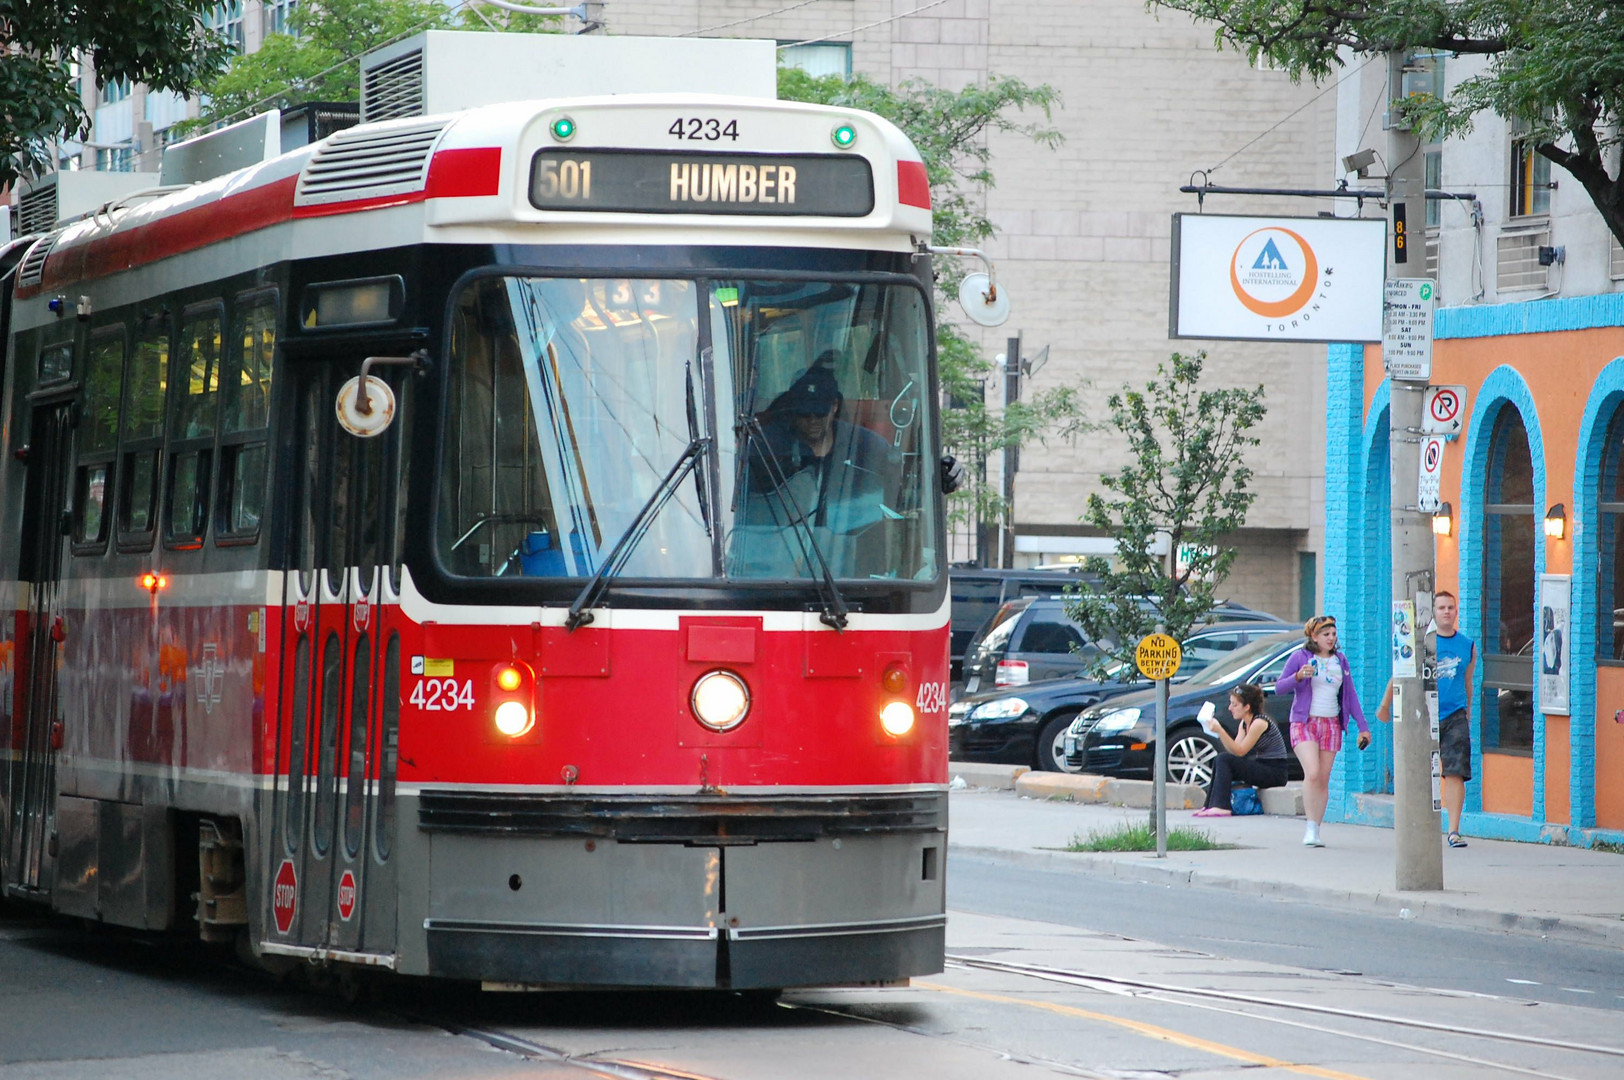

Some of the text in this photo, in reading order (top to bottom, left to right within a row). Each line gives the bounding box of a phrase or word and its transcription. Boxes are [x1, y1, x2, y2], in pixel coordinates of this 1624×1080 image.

[668, 118, 740, 141] 4234
[540, 159, 797, 203] 501 HUMBER
[1242, 278, 1298, 286] INTERNATIONAL
[1248, 271, 1292, 279] HOSTELLING
[1265, 280, 1332, 333] TORONTO
[1139, 646, 1178, 659] PARKING
[1150, 639, 1165, 648] NO
[1140, 659, 1176, 667] BETWEEN
[409, 679, 476, 712] 4234
[916, 682, 946, 713] 4234
[275, 884, 295, 909] STOP
[339, 886, 354, 906] STOP
